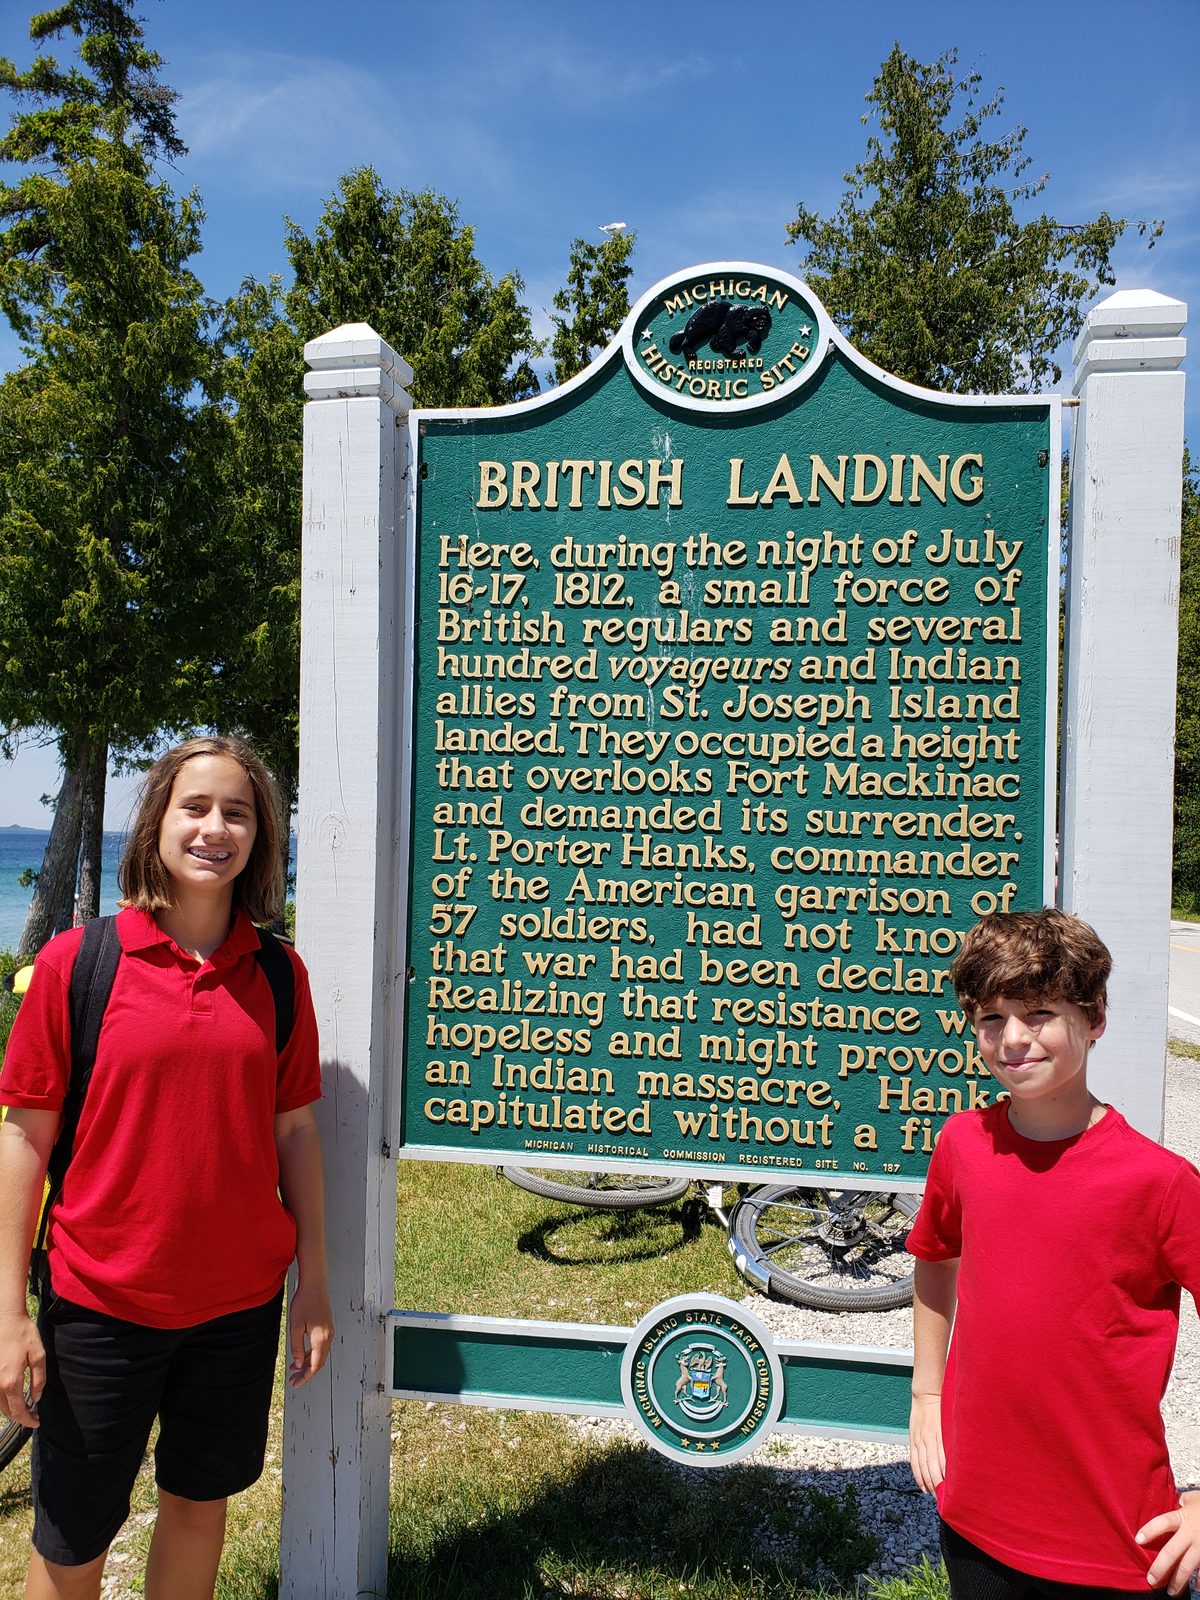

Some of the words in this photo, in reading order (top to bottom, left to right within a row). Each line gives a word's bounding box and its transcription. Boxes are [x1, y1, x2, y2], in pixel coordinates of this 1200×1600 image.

[664, 279, 788, 316] MICHIGAN
[640, 343, 749, 399] HISTORIC
[760, 342, 810, 390] SITE
[688, 358, 764, 371] REGISTERED
[477, 459, 683, 508] BRITISH
[728, 453, 983, 505] LANDING
[439, 534, 539, 567] Here,
[551, 535, 675, 577] during
[684, 533, 747, 566] the
[758, 530, 864, 573] night
[873, 529, 918, 564] of
[926, 528, 1023, 571] July
[439, 572, 528, 605] 16-17,
[555, 572, 634, 606] 1812,
[659, 580, 680, 605] a
[703, 571, 810, 605] small
[835, 571, 949, 603] force
[975, 568, 1022, 602] of
[438, 608, 564, 644] British
[583, 610, 753, 652] regulars
[770, 609, 847, 642] and
[868, 607, 1021, 641] several
[437, 646, 597, 680] hundred
[610, 656, 792, 689] voyageurs
[800, 647, 875, 680] and
[889, 647, 1021, 680] Indian
[436, 684, 535, 716] allies
[551, 686, 645, 718] from
[660, 685, 708, 718] St.
[723, 684, 871, 726] Joseph
[890, 685, 1019, 719] Island
[435, 719, 565, 754] landed.
[569, 722, 669, 761] They
[674, 726, 856, 765] occupied
[861, 734, 884, 758] a
[892, 725, 1020, 772] height
[436, 757, 513, 789] that
[527, 759, 712, 793] overlooks
[727, 760, 808, 795] Fort
[824, 762, 1020, 798] Mackinac
[432, 796, 503, 826] and
[520, 797, 721, 831] demanded
[742, 799, 788, 833] its
[806, 804, 1022, 840] surrender.
[432, 828, 477, 861] Lt.
[488, 830, 611, 865] Porter
[621, 833, 755, 872] Hanks,
[771, 843, 1019, 886] commander
[431, 867, 472, 898] of
[487, 868, 549, 900] the
[566, 869, 755, 908] American
[775, 879, 951, 918] garrison
[971, 883, 1017, 916] of
[429, 904, 477, 935] 57
[499, 907, 655, 943] soldiers,
[687, 911, 761, 946] had
[784, 919, 852, 950] not
[431, 941, 506, 974] that
[523, 952, 596, 977] war
[611, 947, 683, 981] had
[700, 950, 800, 987] been
[816, 957, 951, 994] declar
[428, 976, 606, 1027] Realizing
[620, 986, 698, 1020] that
[713, 992, 921, 1032] resistance
[426, 1015, 592, 1057] hopeless
[608, 1027, 681, 1058] and
[699, 1029, 817, 1075] might
[839, 1040, 991, 1078] provok
[424, 1061, 470, 1085] an
[493, 1057, 614, 1093] Indian
[638, 1071, 841, 1113] massacre,
[424, 1096, 651, 1133] capitulated
[673, 1104, 833, 1146] without
[853, 1124, 877, 1149] a
[524, 1139, 574, 1152] MICHIGAN
[587, 1143, 649, 1158] HISTORICAL
[662, 1148, 726, 1163] COMMISSION
[738, 1153, 803, 1168] REGISTERED
[815, 1159, 838, 1170] SITE
[853, 1161, 869, 1172] NO.
[882, 1162, 901, 1174] 187
[642, 1317, 679, 1354] ISLAND
[685, 1311, 723, 1326] STATE
[730, 1323, 759, 1353] PARK
[635, 1360, 662, 1428] MACKINAC
[740, 1358, 770, 1436] COMMISSION
